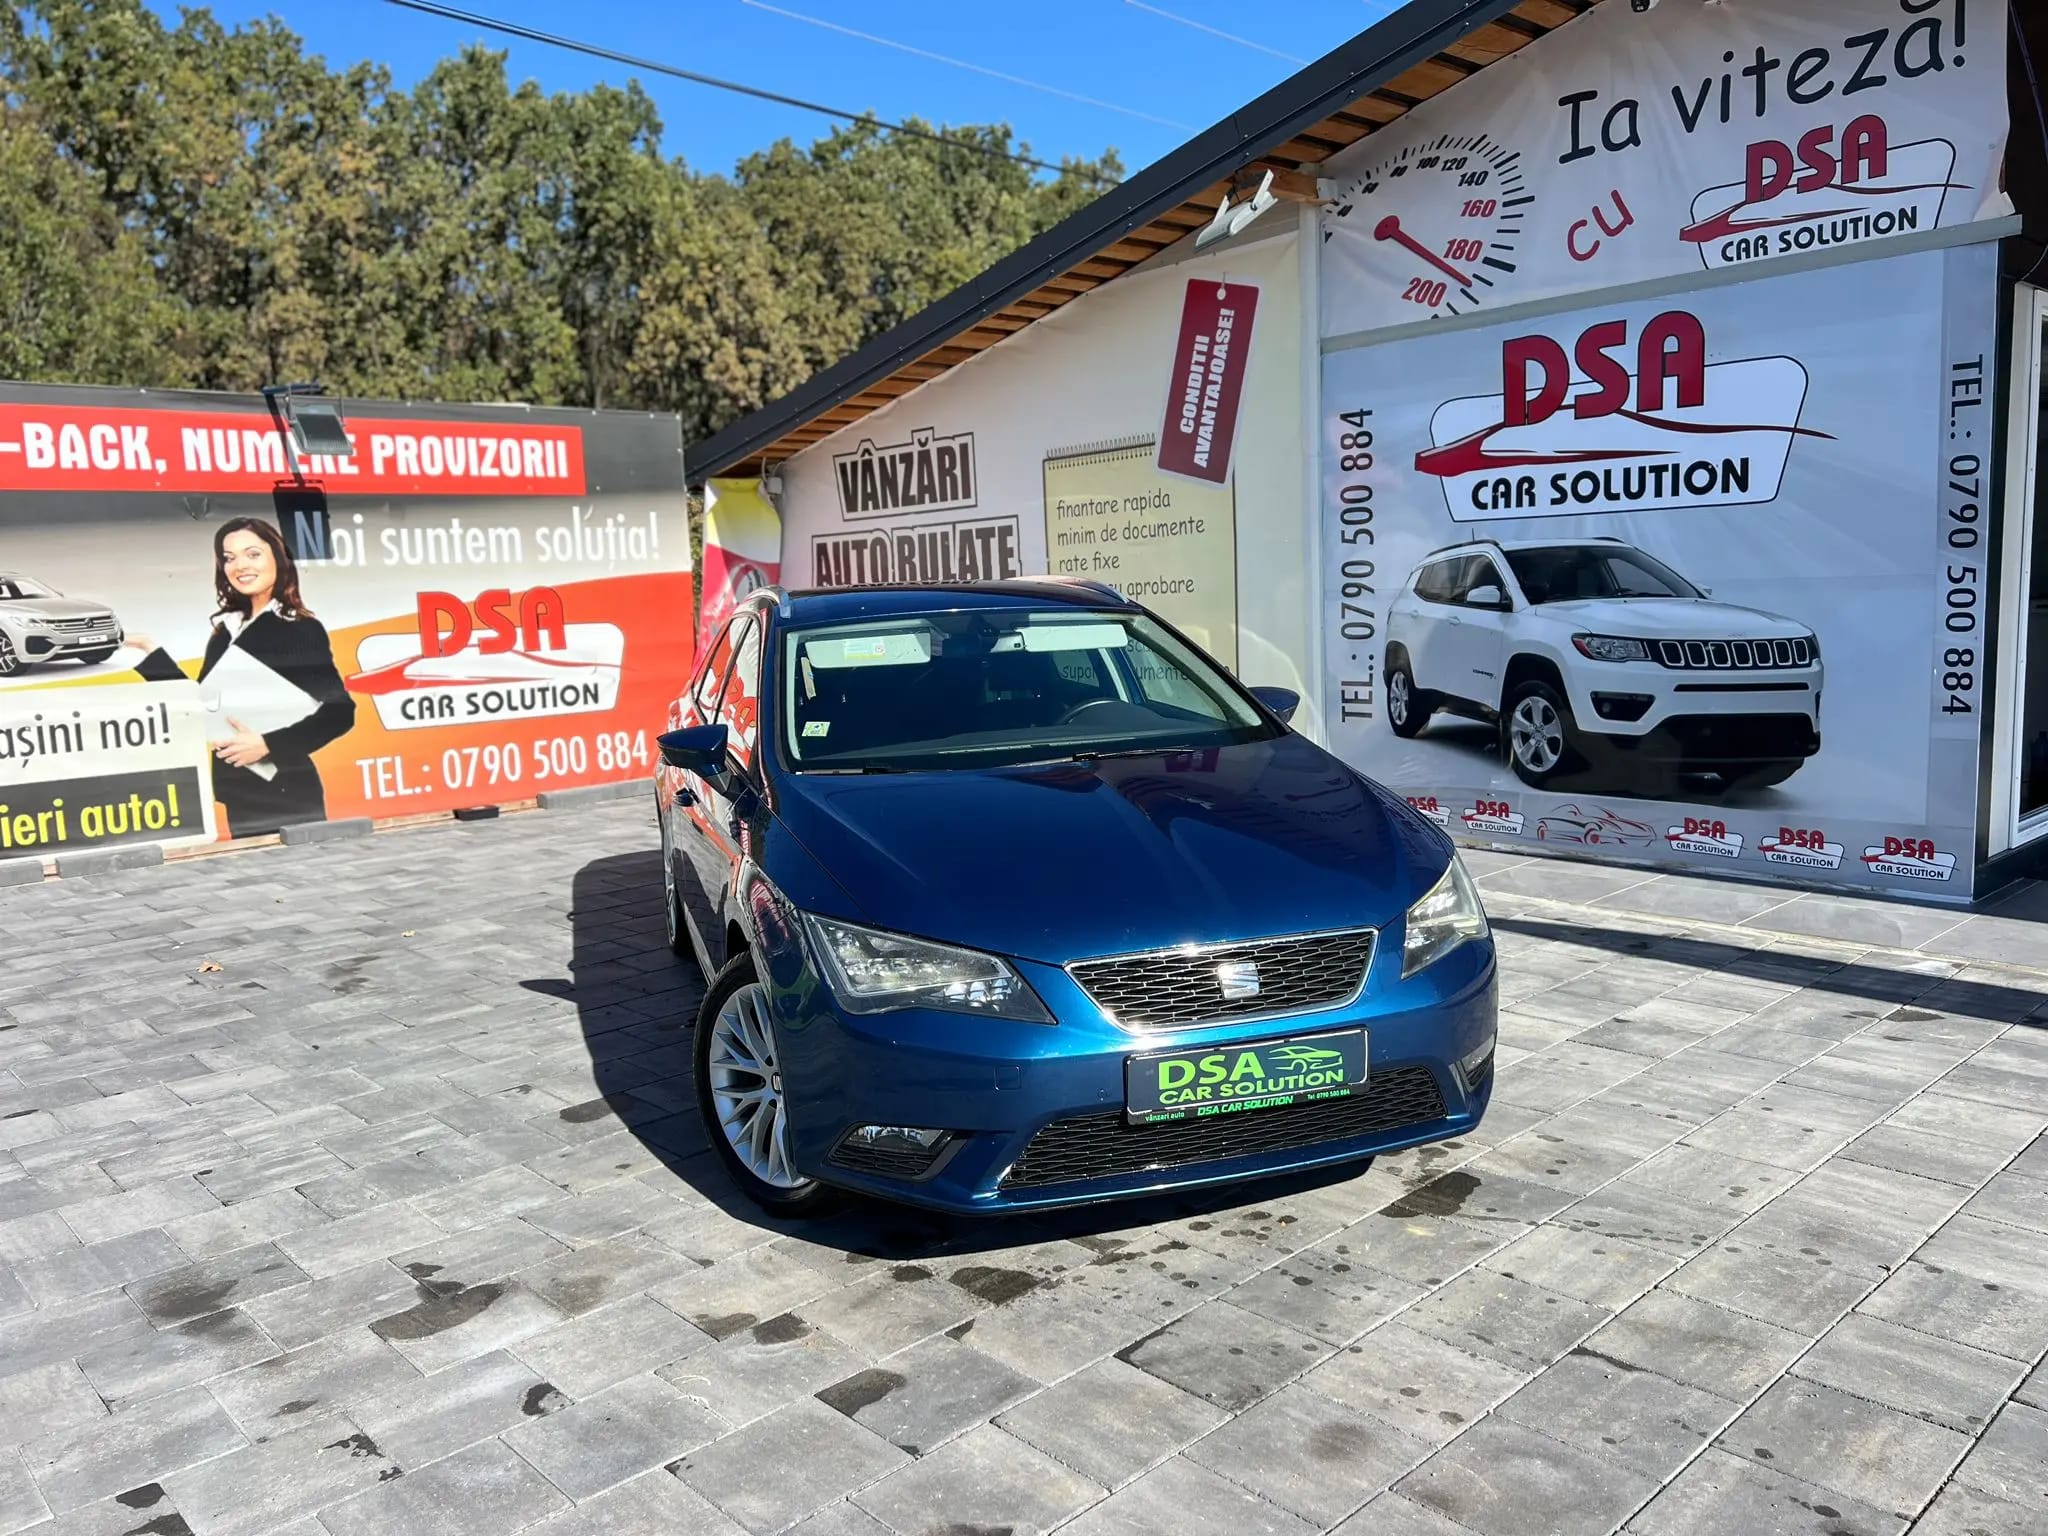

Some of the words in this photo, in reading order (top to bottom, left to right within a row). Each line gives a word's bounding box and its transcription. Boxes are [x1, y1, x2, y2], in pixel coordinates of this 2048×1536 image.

[1558, 90, 1641, 164] Ia
[1416, 156, 1440, 169] 100
[1441, 157, 1468, 171] 120
[1457, 170, 1489, 187] 140
[1745, 114, 1888, 203] DSA
[1460, 199, 1497, 217] 160
[1567, 190, 1634, 261] cu
[1443, 238, 1483, 262] 180
[1721, 234, 1769, 262] CAR
[1779, 205, 1917, 253] SOLUTION
[1401, 277, 1447, 307] 200
[1180, 335, 1210, 434] CONDITII
[1193, 308, 1235, 468] AVANTAJOASE!
[1503, 310, 1705, 428] DSA
[371, 434, 568, 479] PROVIZORII
[1340, 408, 1373, 472] 884
[839, 436, 971, 513] VÂNZĂRI
[1472, 475, 1536, 510] CAR
[1550, 457, 1750, 506] SOLUTION
[1057, 498, 1119, 520] finantare
[1123, 488, 1171, 516] rapida
[1340, 485, 1374, 545] 500
[1948, 455, 1980, 549] 0790
[294, 511, 364, 567] Noi
[381, 519, 523, 566] suntem
[1057, 528, 1096, 546] minim
[1101, 523, 1118, 543] de
[1123, 516, 1205, 541] documente
[816, 537, 889, 587] AUTO
[896, 524, 1017, 584] RULATE
[1059, 555, 1088, 573] rate
[1093, 552, 1120, 571] fixe
[1127, 575, 1195, 601] aprobare
[1341, 560, 1375, 640] 0790
[1946, 565, 1977, 633] 500
[417, 586, 567, 658] DSA
[400, 694, 455, 721] CAR
[466, 683, 599, 716] SOLUTION
[1942, 648, 1974, 715] 884
[100, 702, 170, 749] noi!
[442, 742, 521, 789] 0790
[533, 736, 587, 779] 500
[596, 730, 649, 771] 884
[80, 784, 181, 838] auto!
[1475, 800, 1510, 818] DSA
[1484, 824, 1517, 833] SOLUTION
[1684, 817, 1725, 839] DSA
[1676, 842, 1691, 850] CAR
[1693, 843, 1734, 856] SOLUTION
[1771, 853, 1787, 861] CAR
[1790, 855, 1833, 867] SOLUTION
[1779, 827, 1824, 850] DSA
[1884, 836, 1934, 860] DSA
[1875, 864, 1893, 872] CAR
[1896, 866, 1944, 879] SOLUTION
[1158, 1051, 1265, 1090] DSA
[1159, 1085, 1212, 1105] CAR
[1220, 1068, 1344, 1095] SOLUTION
[1197, 1106, 1219, 1116] DSA
[1221, 1103, 1242, 1113] CAR
[1243, 1095, 1293, 1111] SOLUTION
